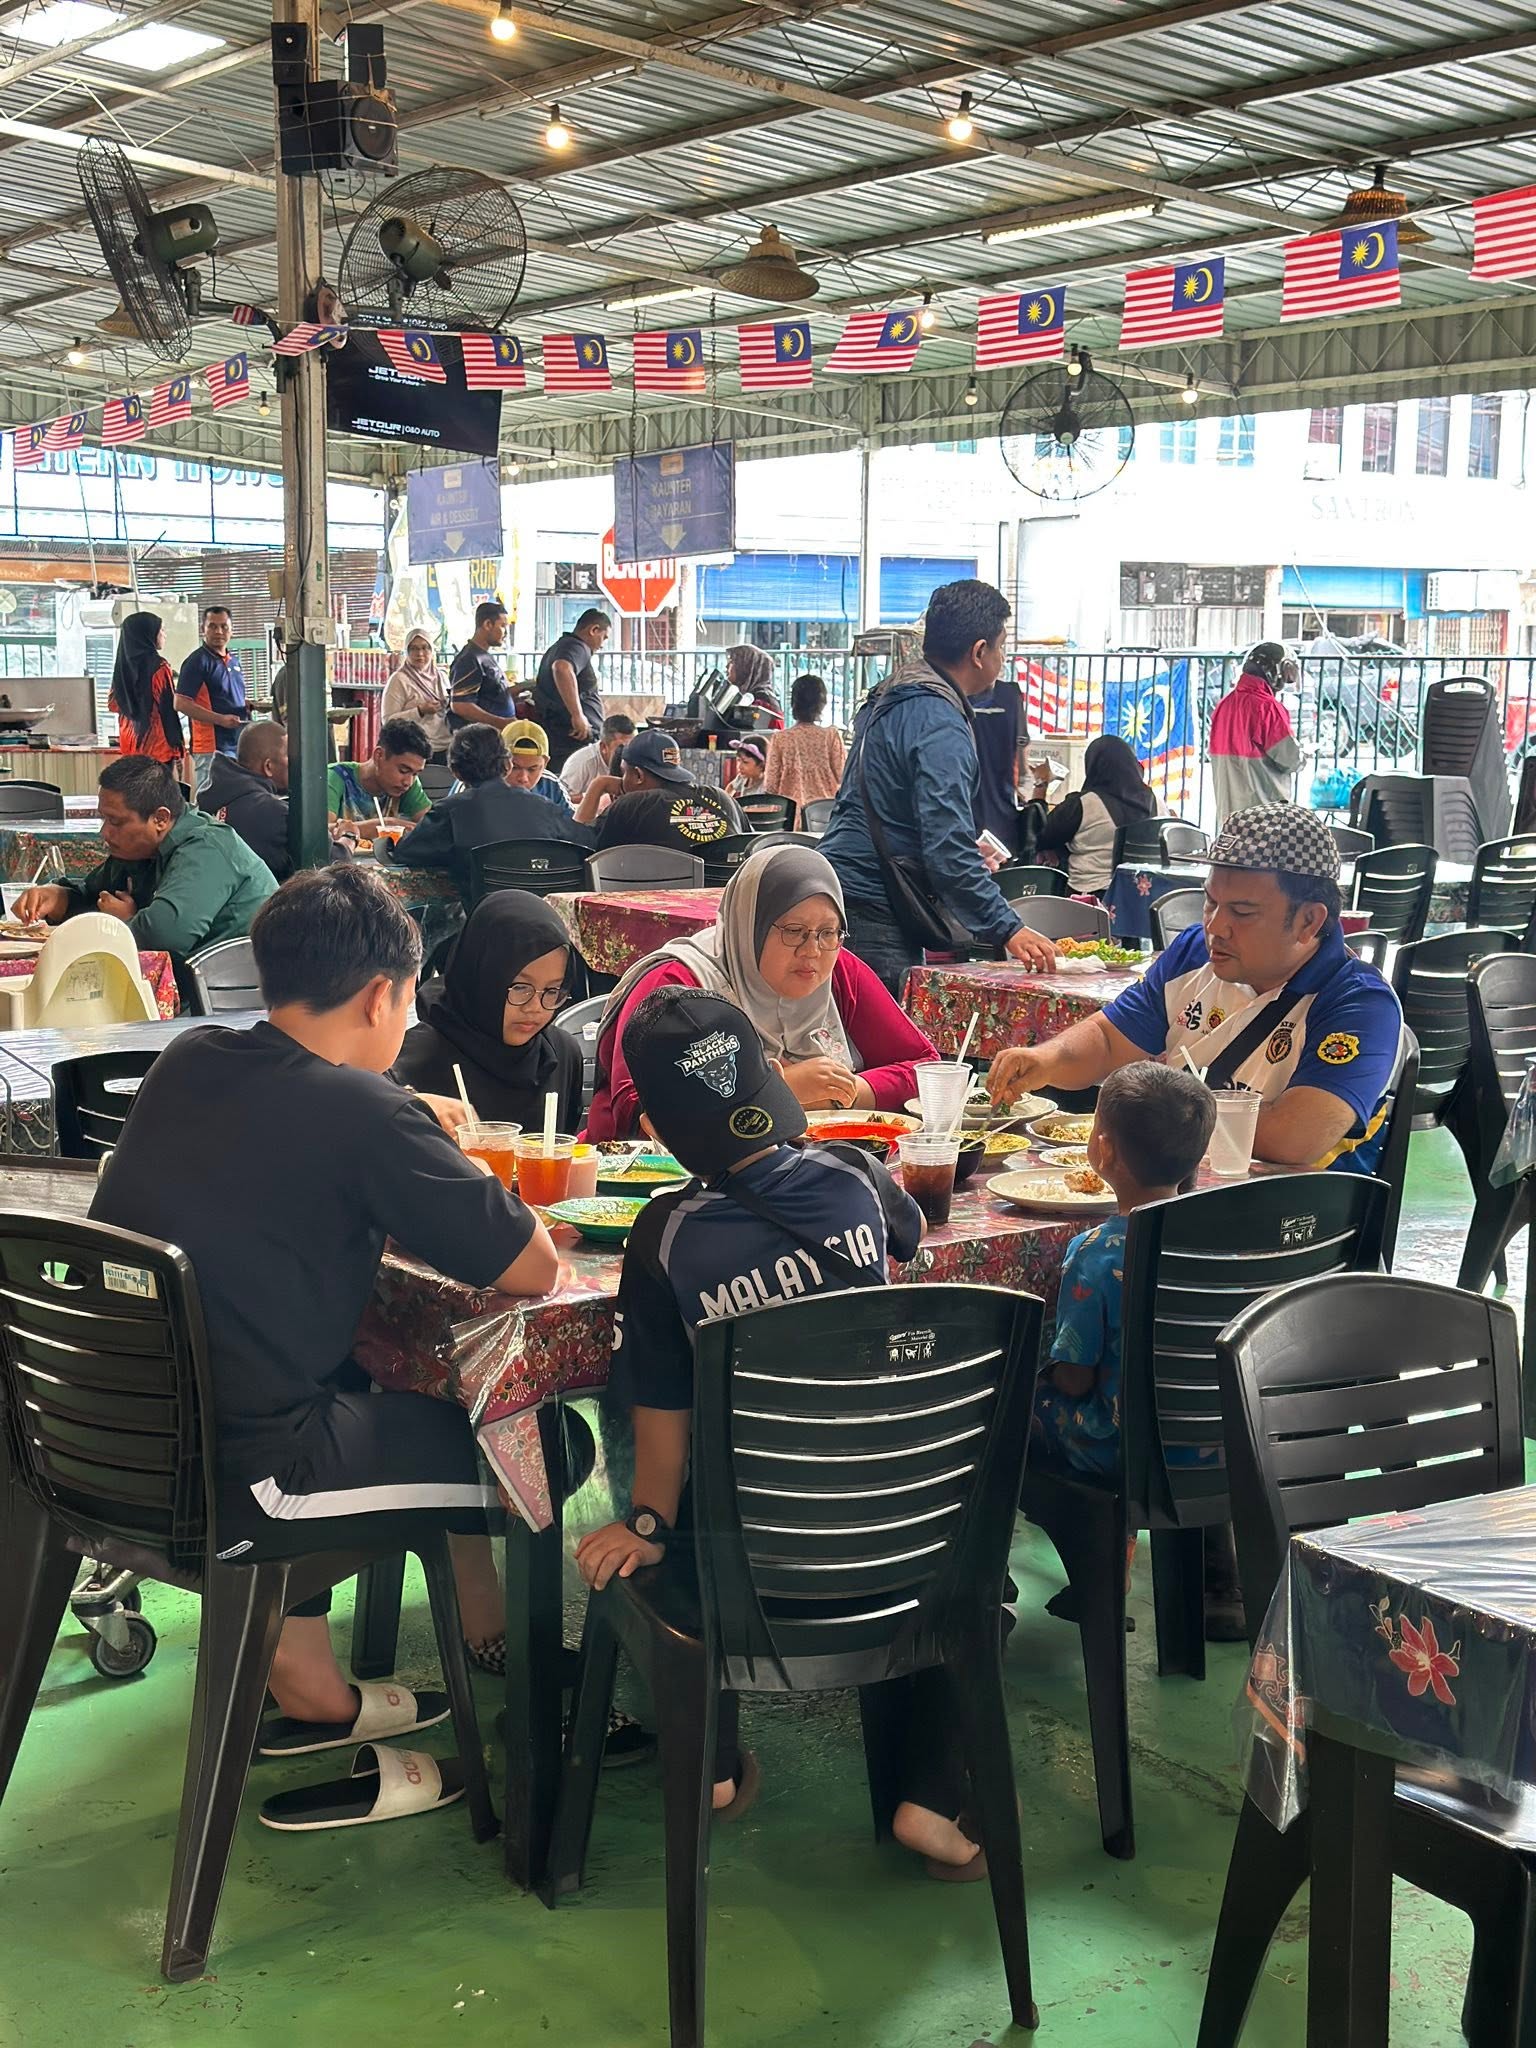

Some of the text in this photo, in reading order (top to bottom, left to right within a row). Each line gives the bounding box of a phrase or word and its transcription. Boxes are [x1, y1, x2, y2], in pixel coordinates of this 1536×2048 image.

[351, 418, 401, 431] JETOUR
[421, 428, 440, 438] AUTO
[681, 1037, 738, 1072] PANTHERS
[691, 1037, 725, 1058] BLACK
